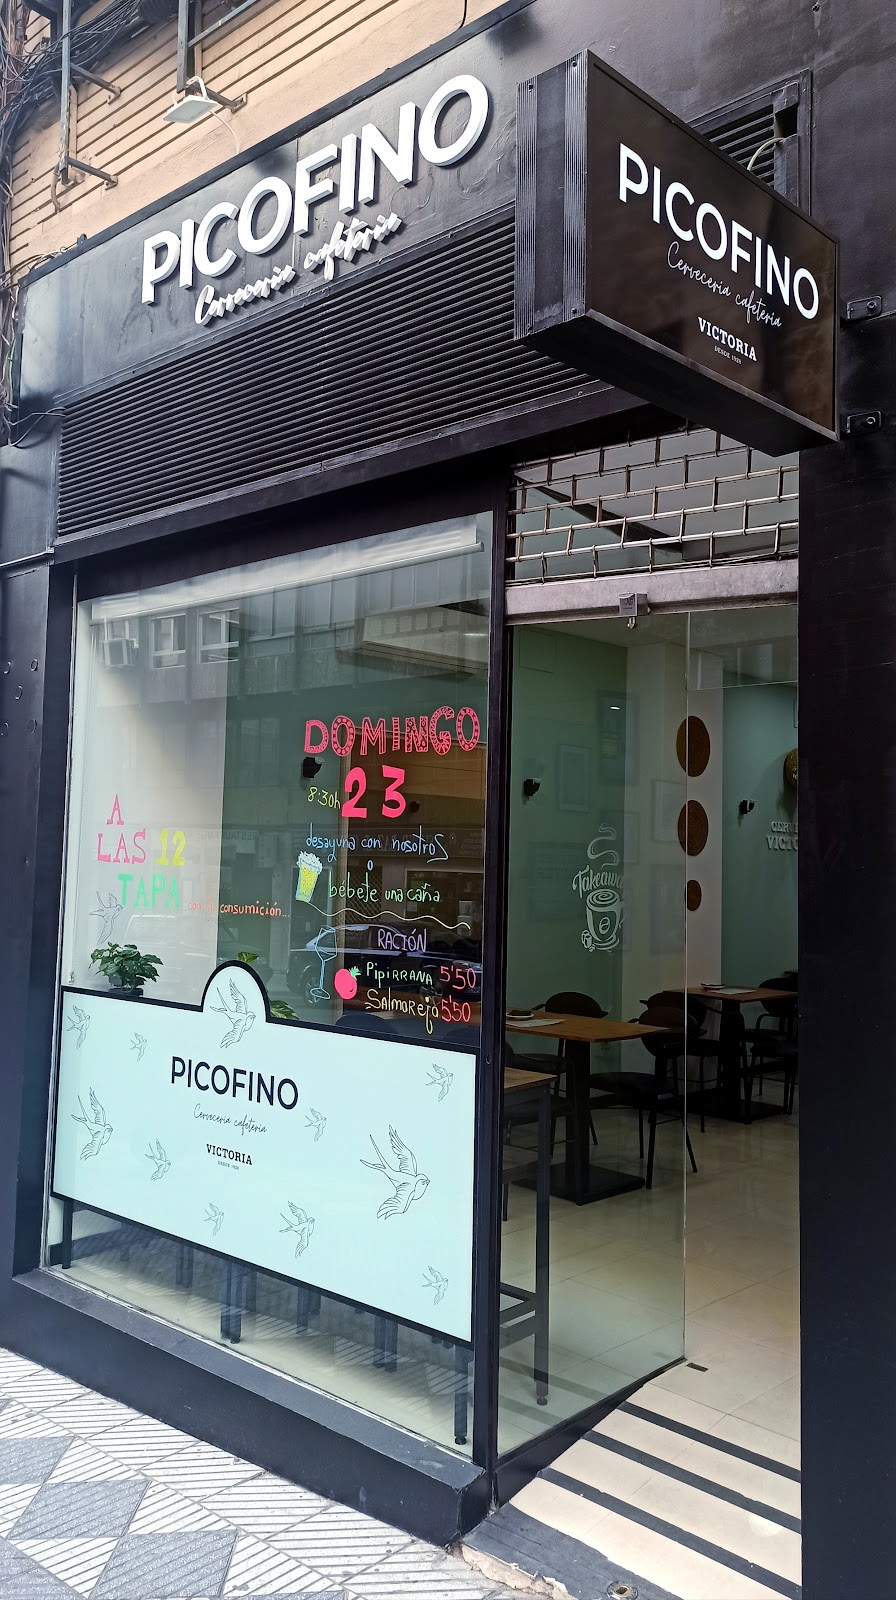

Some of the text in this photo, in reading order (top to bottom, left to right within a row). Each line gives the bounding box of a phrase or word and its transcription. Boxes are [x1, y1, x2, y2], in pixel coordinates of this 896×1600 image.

[141, 74, 490, 305] PICOFINO
[303, 212, 403, 281] cafeteria
[619, 142, 819, 320] PICOFINO
[667, 241, 782, 327] Cerveceria cafeteria
[698, 316, 757, 361] VICTORIA
[714, 345, 731, 359] DESDE
[304, 705, 480, 757] DOMINGO
[106, 793, 125, 825] A
[307, 786, 341, 809] 8:30h
[97, 828, 186, 866] LAS 12
[306, 822, 356, 863] desayuna
[361, 838, 382, 849] con
[117, 873, 181, 909] TAPA
[384, 888, 404, 903] una
[406, 882, 441, 902] caña
[572, 864, 630, 899] Takeawa
[377, 928, 427, 953] RACIÓN
[440, 965, 477, 990] 5'50
[441, 994, 471, 1023] 5'50
[171, 1055, 299, 1110] PICOFINO
[233, 1114, 267, 1136] cafeteria
[206, 1143, 253, 1165] VICTORIA
